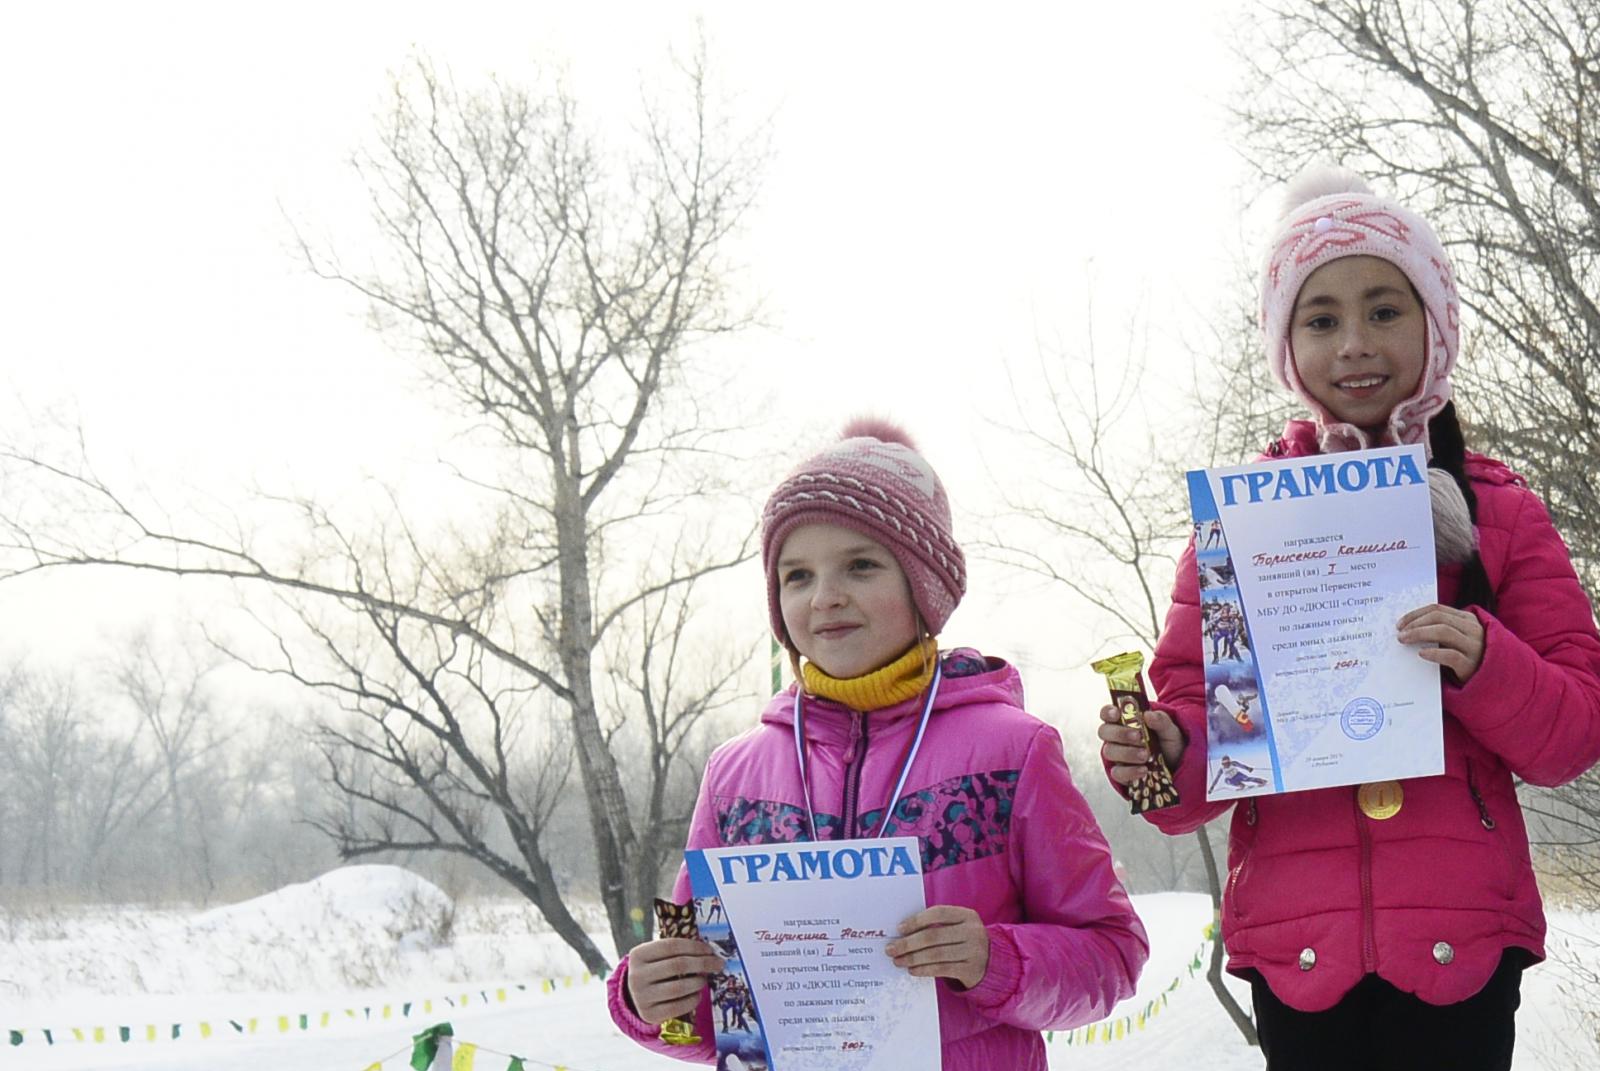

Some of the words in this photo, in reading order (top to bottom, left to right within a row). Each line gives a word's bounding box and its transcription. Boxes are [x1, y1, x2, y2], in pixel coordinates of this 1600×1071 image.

[1220, 454, 1425, 506] ГРАМОТА
[1350, 562, 1377, 572] место
[1274, 587, 1318, 598] открытом
[1321, 580, 1372, 593] Первенстве
[719, 846, 919, 884] ГРАМОТА
[848, 946, 873, 954] место
